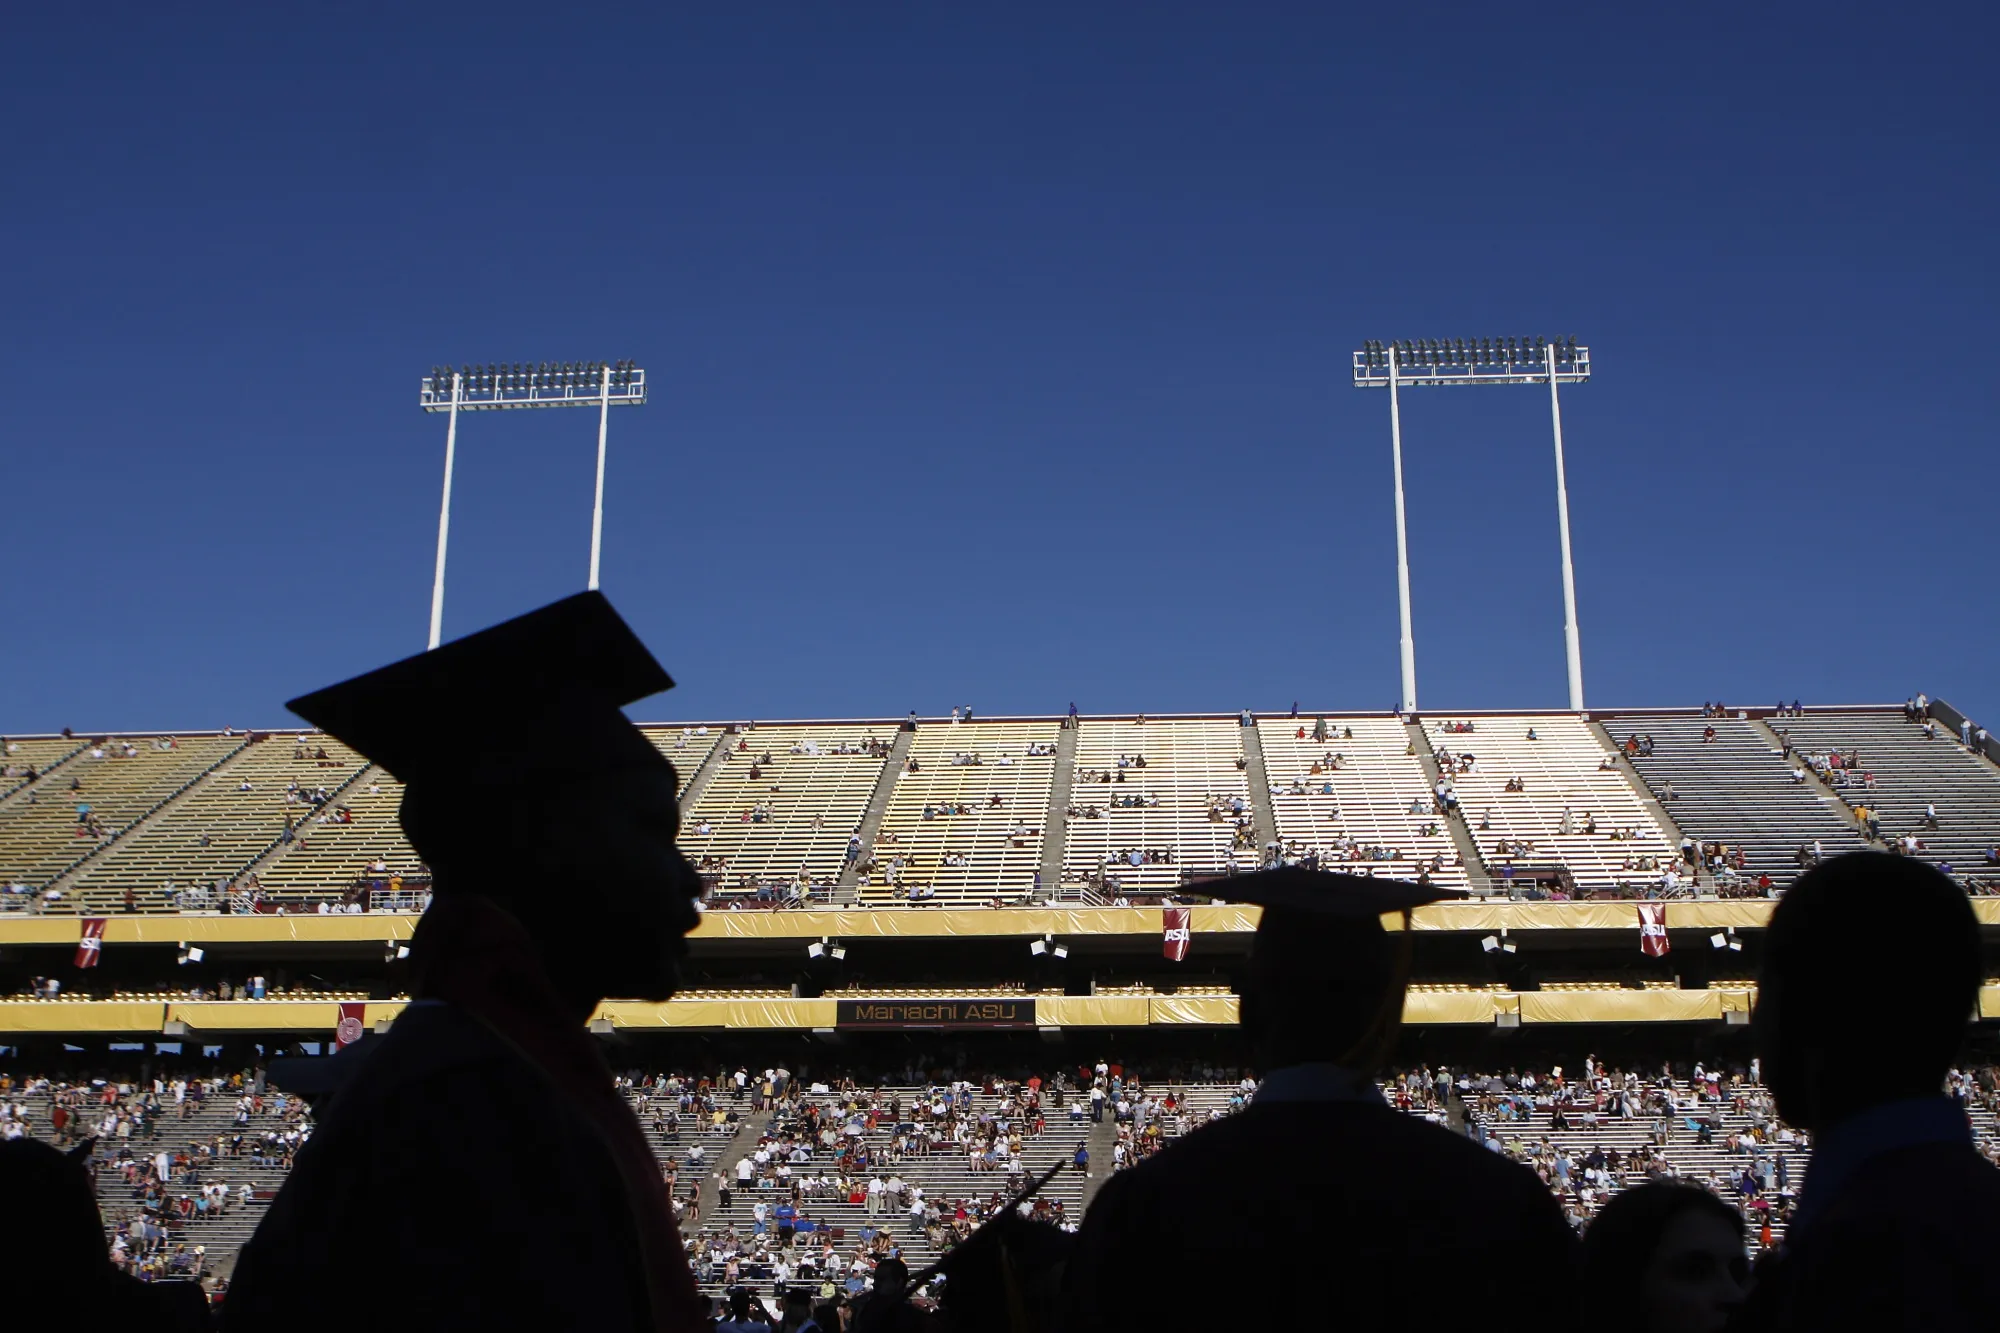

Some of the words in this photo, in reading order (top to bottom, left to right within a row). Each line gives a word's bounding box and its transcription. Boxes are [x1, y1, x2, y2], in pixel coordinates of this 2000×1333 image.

[1165, 929, 1189, 942] ASU
[855, 1004, 957, 1020] Mariachi
[964, 1004, 1016, 1020] ASU
